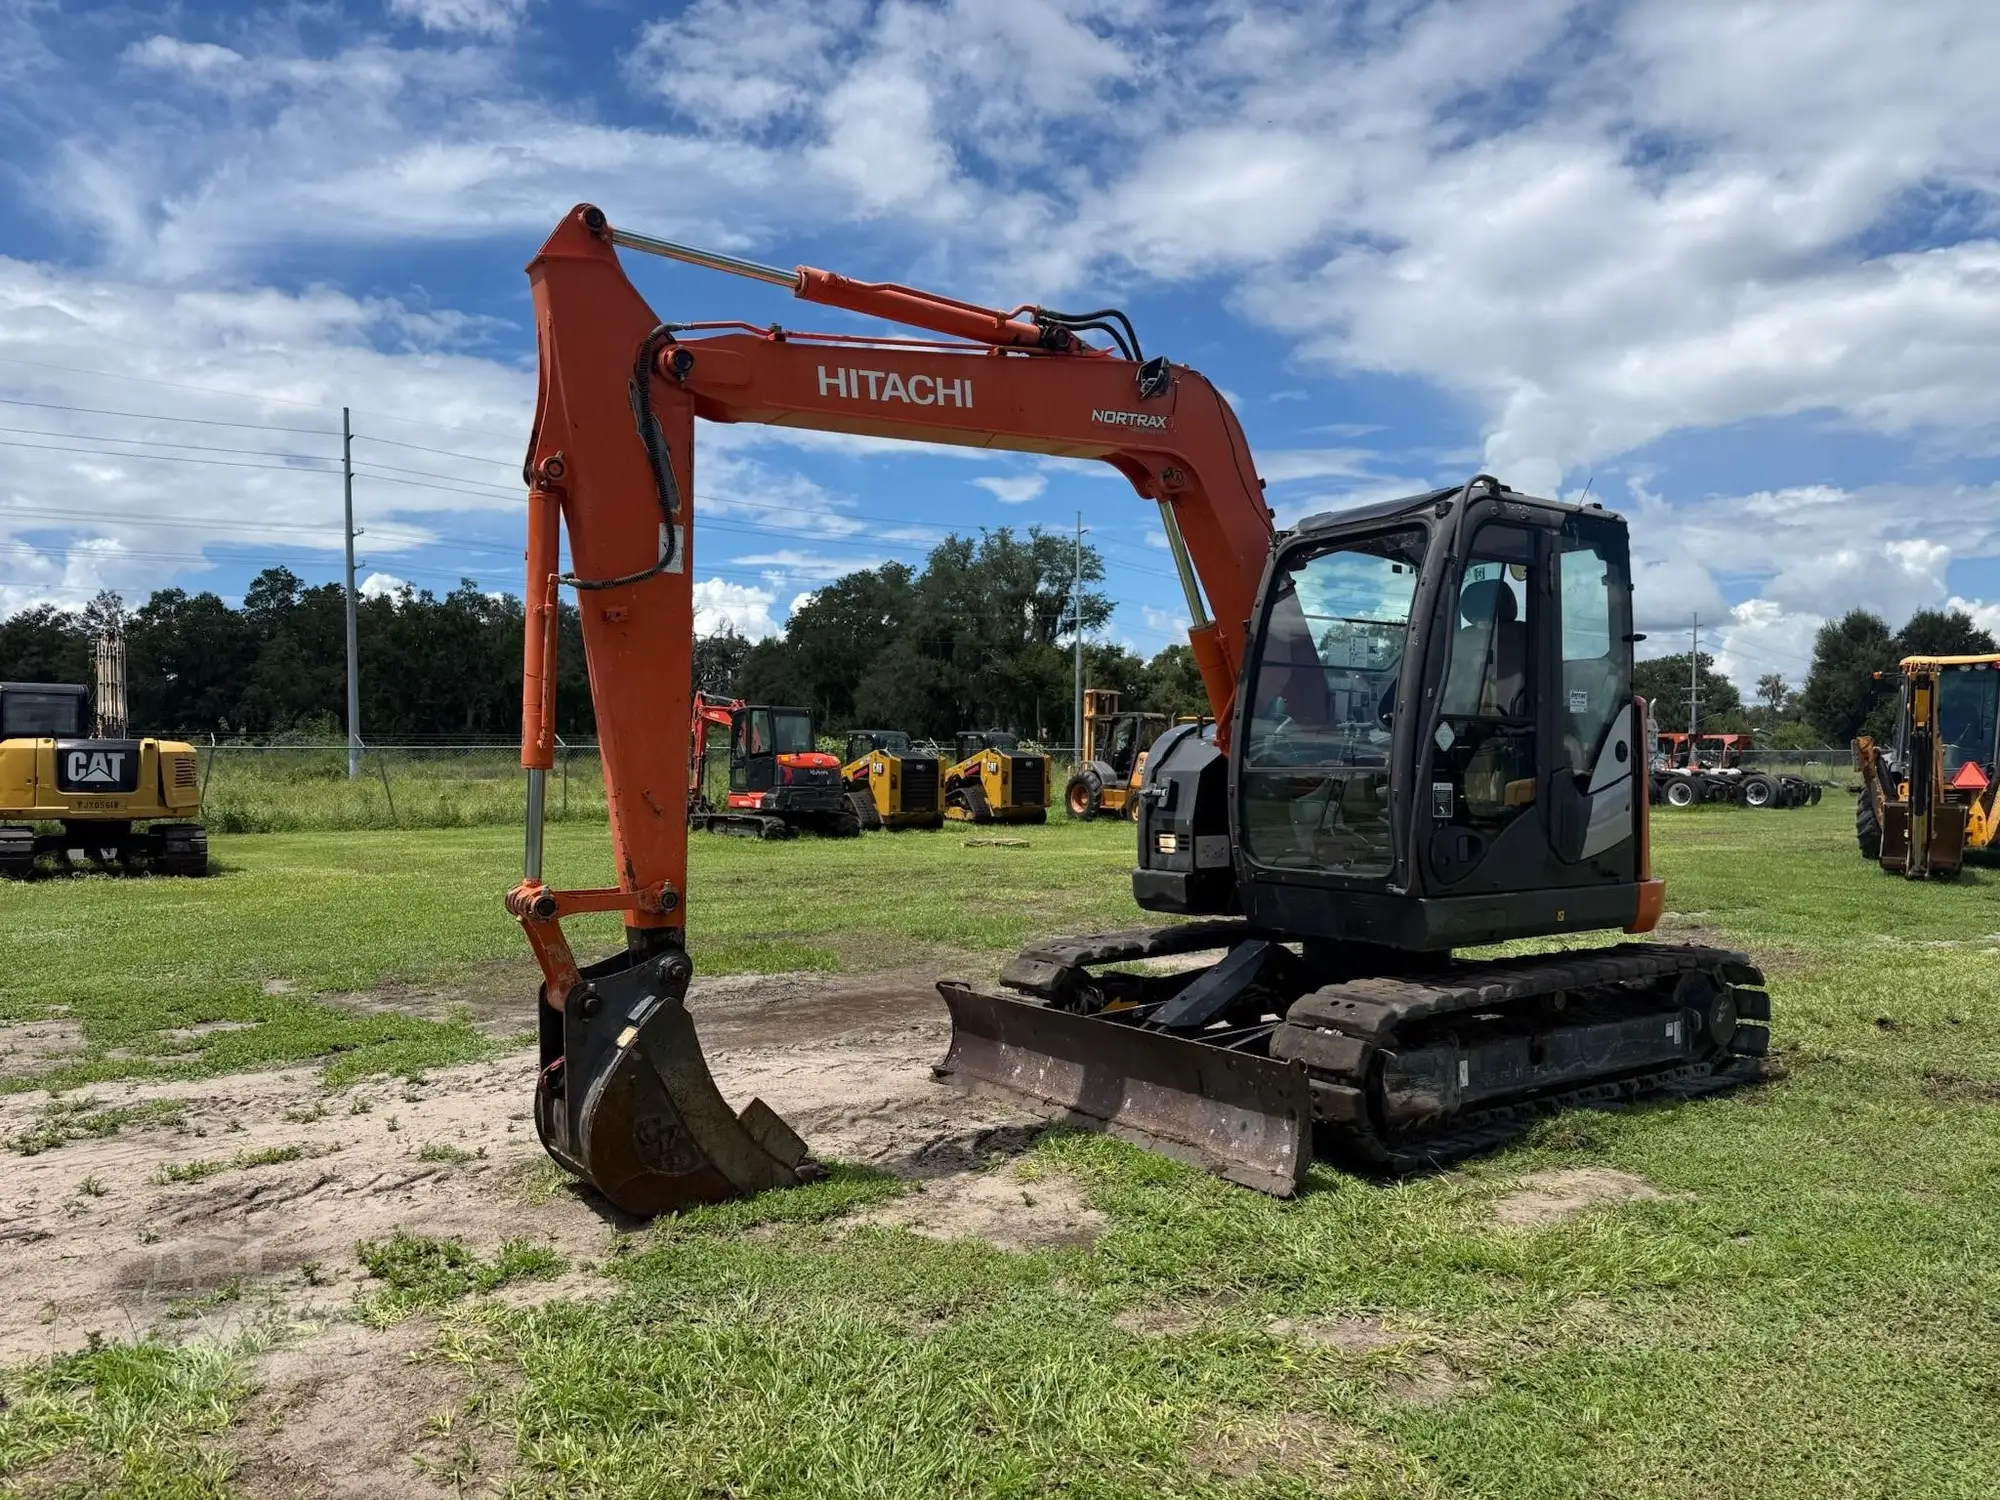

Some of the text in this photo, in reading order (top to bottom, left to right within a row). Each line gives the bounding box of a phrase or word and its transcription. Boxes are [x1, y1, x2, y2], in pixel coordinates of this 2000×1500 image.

[817, 365, 973, 408] HITACHI
[1091, 409, 1167, 429] NORTRAX
[68, 751, 126, 782] CAT
[872, 762, 883, 774] CAT
